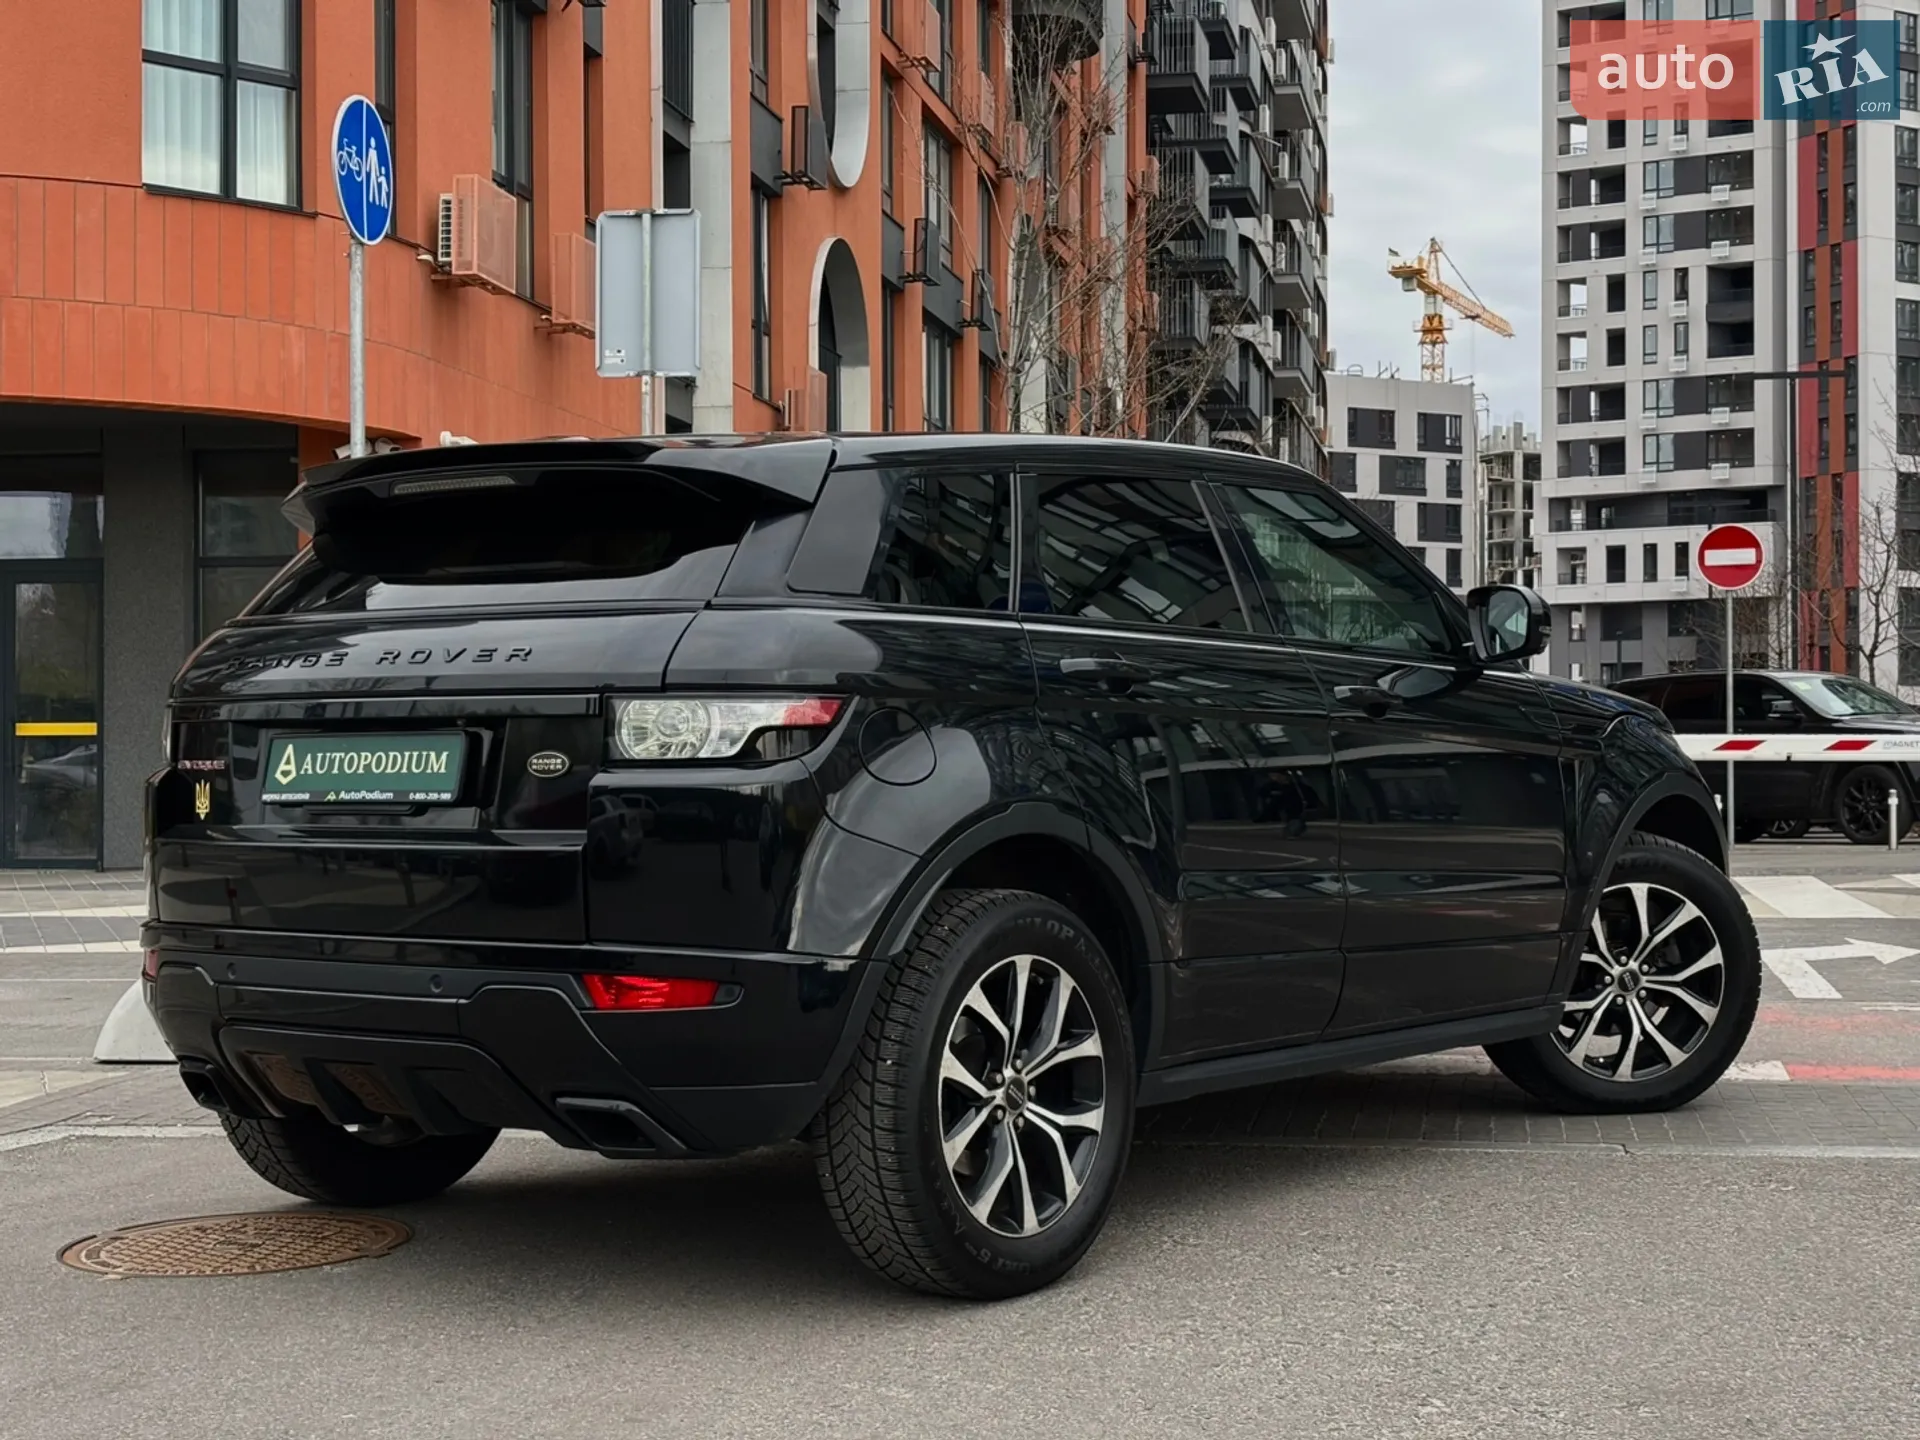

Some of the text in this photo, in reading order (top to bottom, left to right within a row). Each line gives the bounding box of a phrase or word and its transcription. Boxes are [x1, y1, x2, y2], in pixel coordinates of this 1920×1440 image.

[225, 646, 534, 672] RANGE ROVER
[300, 751, 449, 775] AUTOPODIUM
[338, 790, 394, 800] AutoPodium
